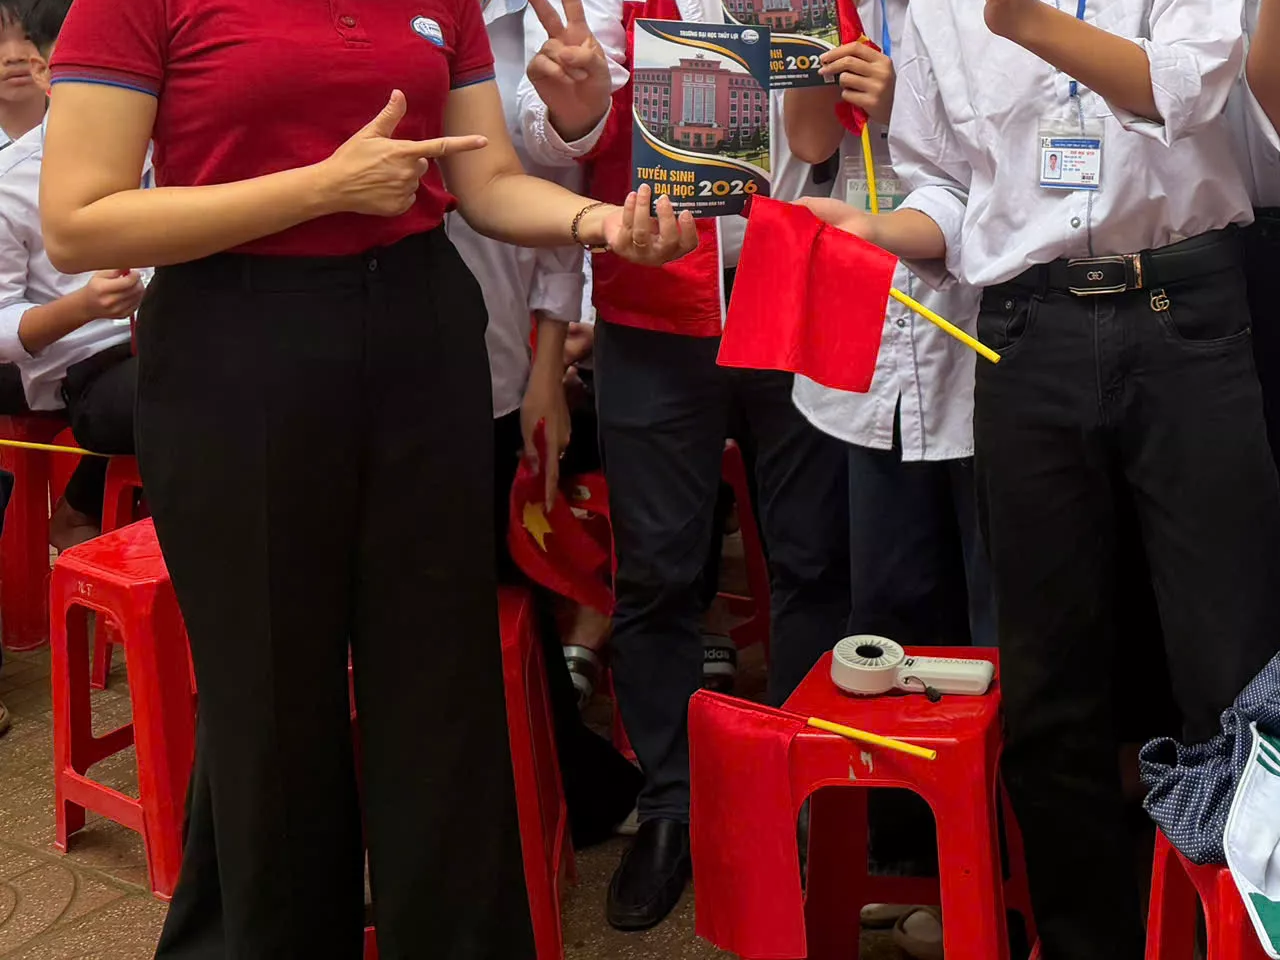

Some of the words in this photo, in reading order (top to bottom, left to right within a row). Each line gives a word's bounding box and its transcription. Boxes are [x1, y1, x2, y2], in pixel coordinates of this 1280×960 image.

[770, 60, 785, 73] ỌC
[786, 54, 821, 70] 202
[637, 164, 667, 181] TUYỂN
[670, 171, 695, 182] SINH
[673, 185, 695, 198] HỌC
[698, 179, 759, 197] 2026
